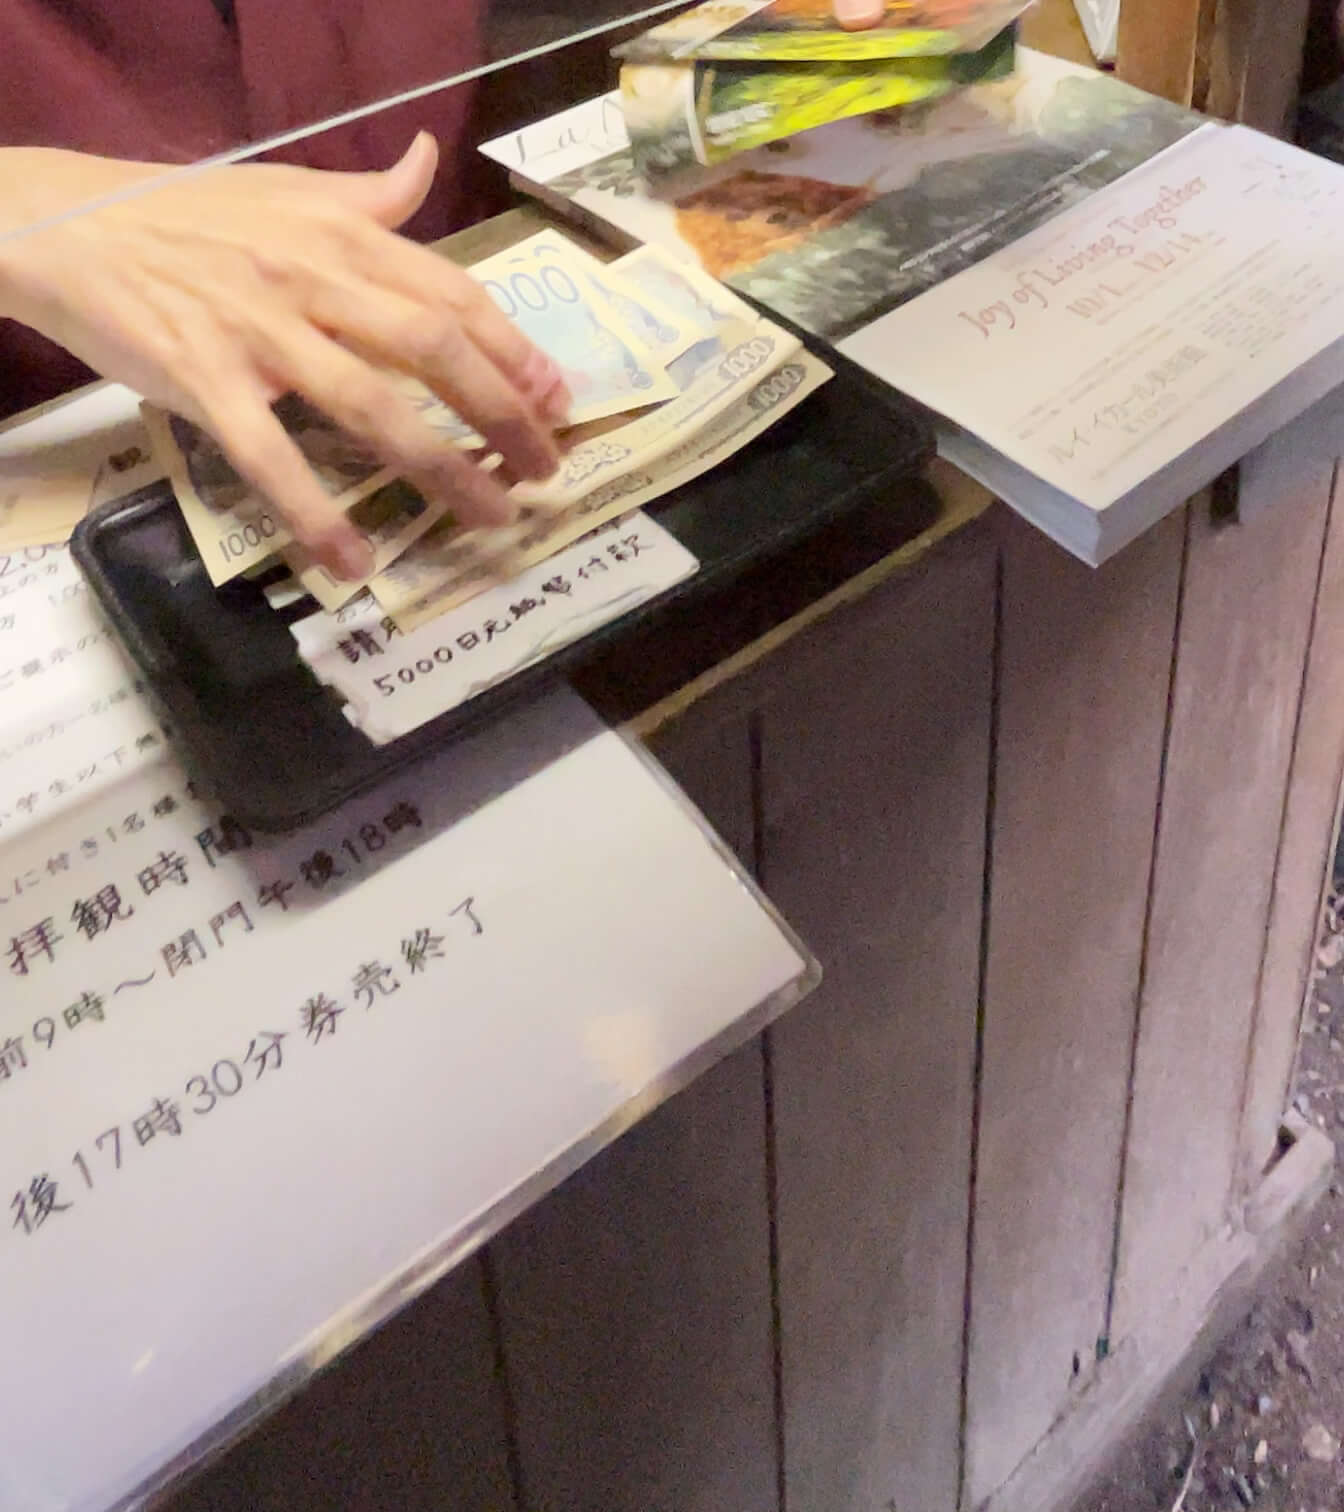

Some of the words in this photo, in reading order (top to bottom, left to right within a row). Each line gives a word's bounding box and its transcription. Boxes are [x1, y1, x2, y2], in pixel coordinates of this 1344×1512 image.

[957, 299, 1017, 339] Joy
[1011, 270, 1049, 309] of
[1031, 234, 1136, 287] Living
[1106, 176, 1205, 235] Together
[482, 265, 580, 319] 000
[724, 339, 772, 379] 1000
[757, 365, 803, 407] 1000
[217, 514, 277, 564] 1000
[3, 813, 254, 976] 拝観時間
